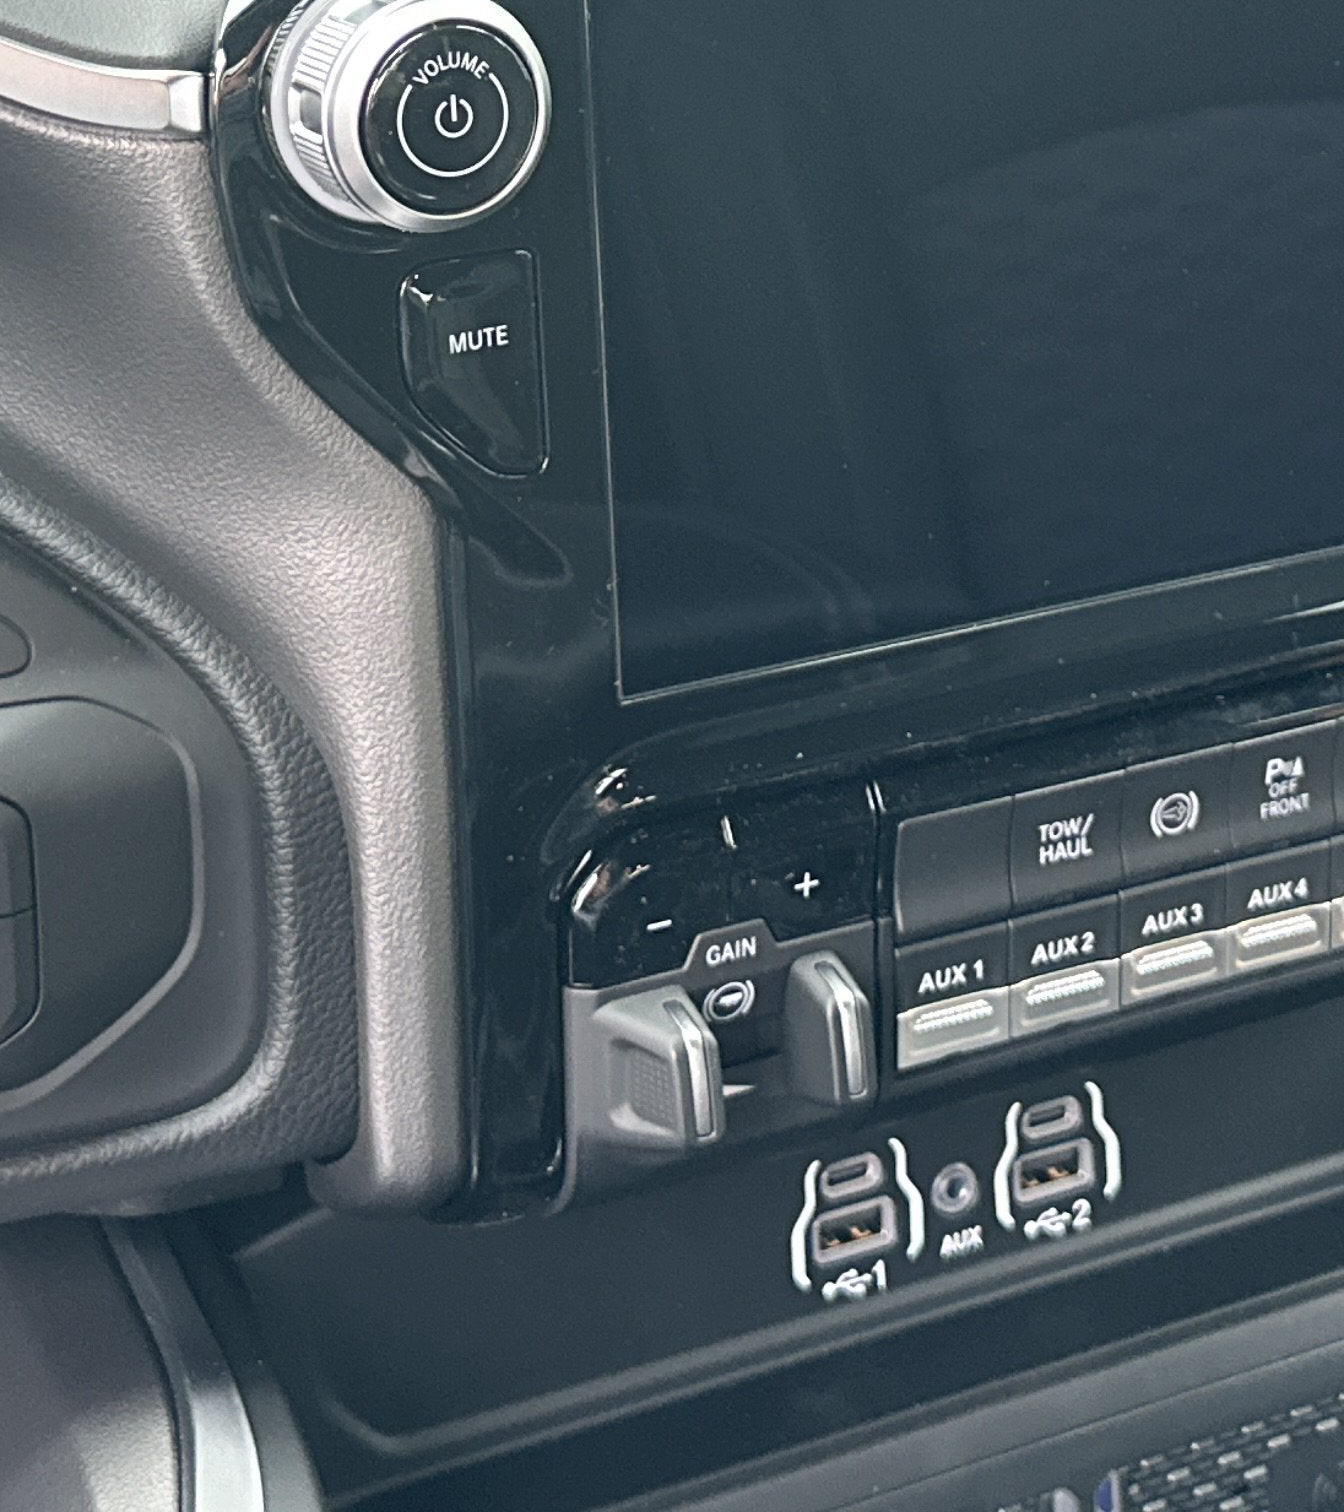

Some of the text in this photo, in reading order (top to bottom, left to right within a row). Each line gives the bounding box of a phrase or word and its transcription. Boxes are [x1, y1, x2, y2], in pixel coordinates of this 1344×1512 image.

[412, 51, 490, 86] VOLUME
[449, 325, 509, 354] MUTE
[1268, 778, 1298, 798] OFF
[1260, 793, 1309, 819] FRONT
[1039, 814, 1094, 843] TOW/
[1039, 837, 1093, 865] HAUL
[1248, 878, 1308, 910] AUX 4
[1142, 903, 1204, 935] AUX 3
[706, 936, 756, 965] GAIN
[1031, 932, 1095, 965] AUX 2
[919, 960, 984, 993] AUX 1
[1072, 1198, 1092, 1231] 2
[940, 1225, 983, 1259] AUX
[872, 1259, 887, 1289] 1
